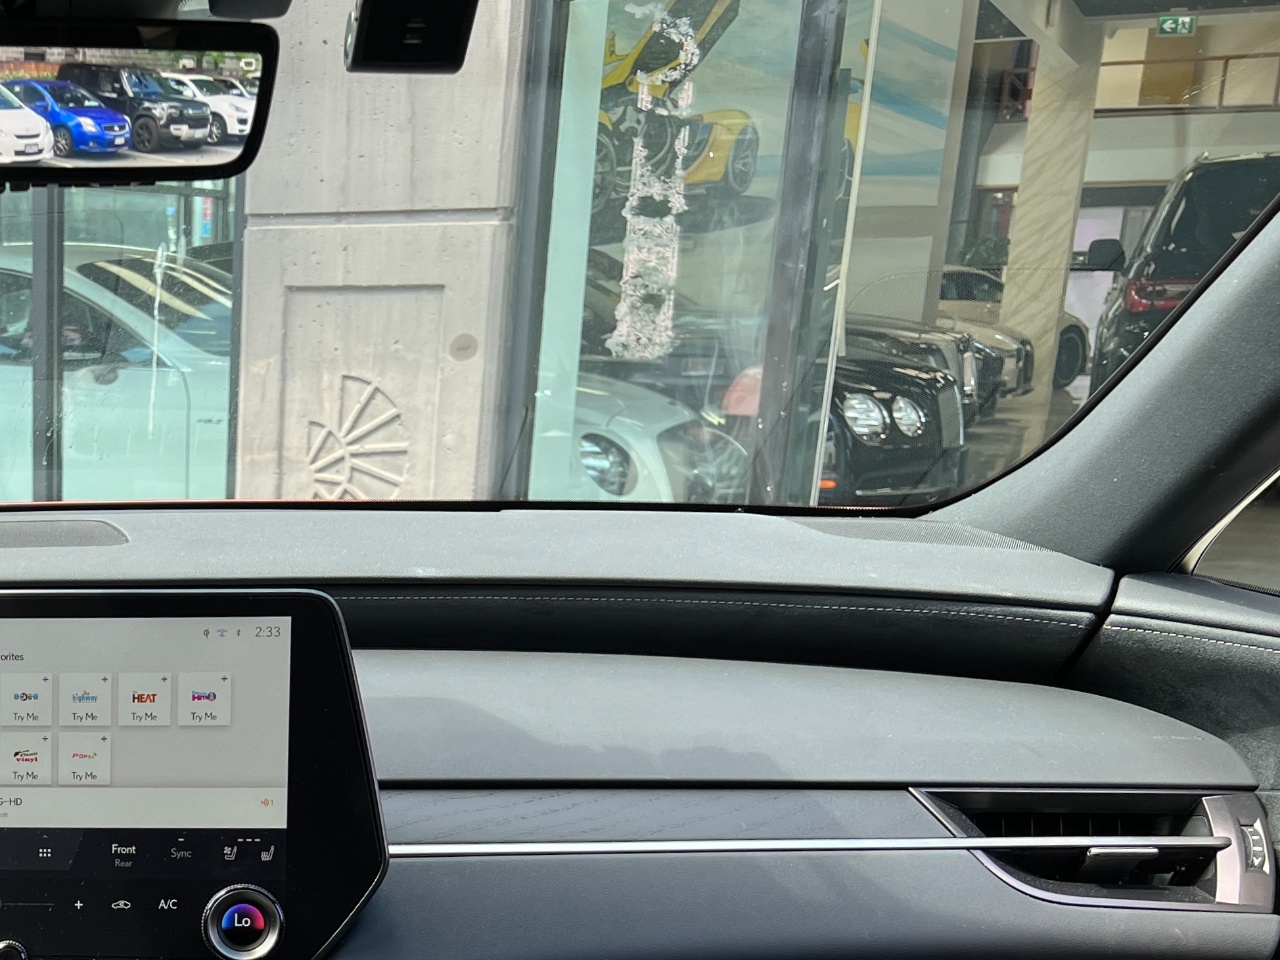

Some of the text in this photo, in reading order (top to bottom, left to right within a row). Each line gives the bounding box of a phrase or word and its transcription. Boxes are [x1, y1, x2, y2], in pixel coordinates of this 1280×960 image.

[255, 626, 280, 637] 2:33
[132, 694, 157, 703] HEAT
[13, 713, 39, 722] Try Me
[72, 713, 98, 722] Try Me
[131, 712, 158, 722] Try Me
[191, 712, 217, 722] Try Me
[13, 772, 38, 781] Try Me
[72, 772, 97, 781] Try Me
[112, 844, 136, 854] Front
[171, 848, 192, 859] Sync
[115, 859, 132, 868] Rear
[158, 899, 178, 910] A/C
[234, 913, 251, 927] Lo
